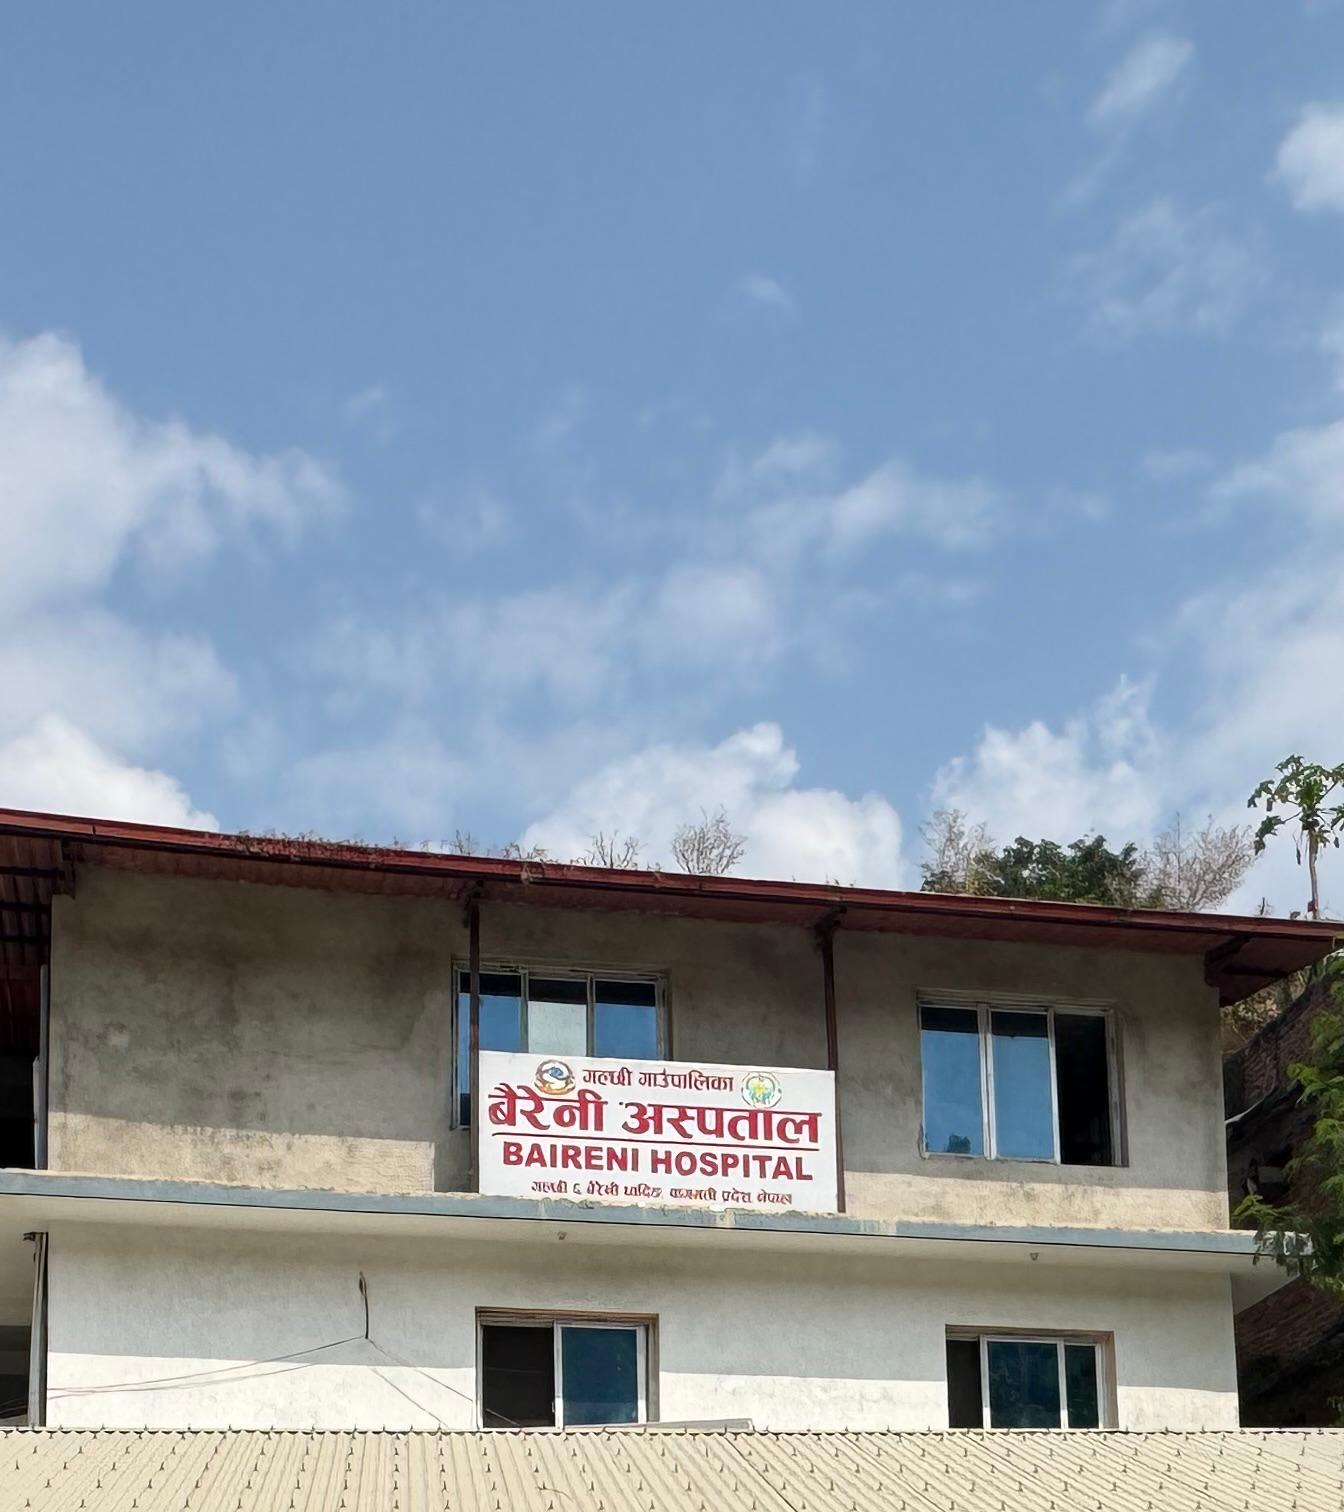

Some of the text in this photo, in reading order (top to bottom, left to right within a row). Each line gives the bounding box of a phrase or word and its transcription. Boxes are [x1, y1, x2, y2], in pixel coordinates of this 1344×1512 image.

[488, 1082, 823, 1144] बैरेनी अस्पताल
[502, 1141, 813, 1181] BAIRENI HOSPITAL
